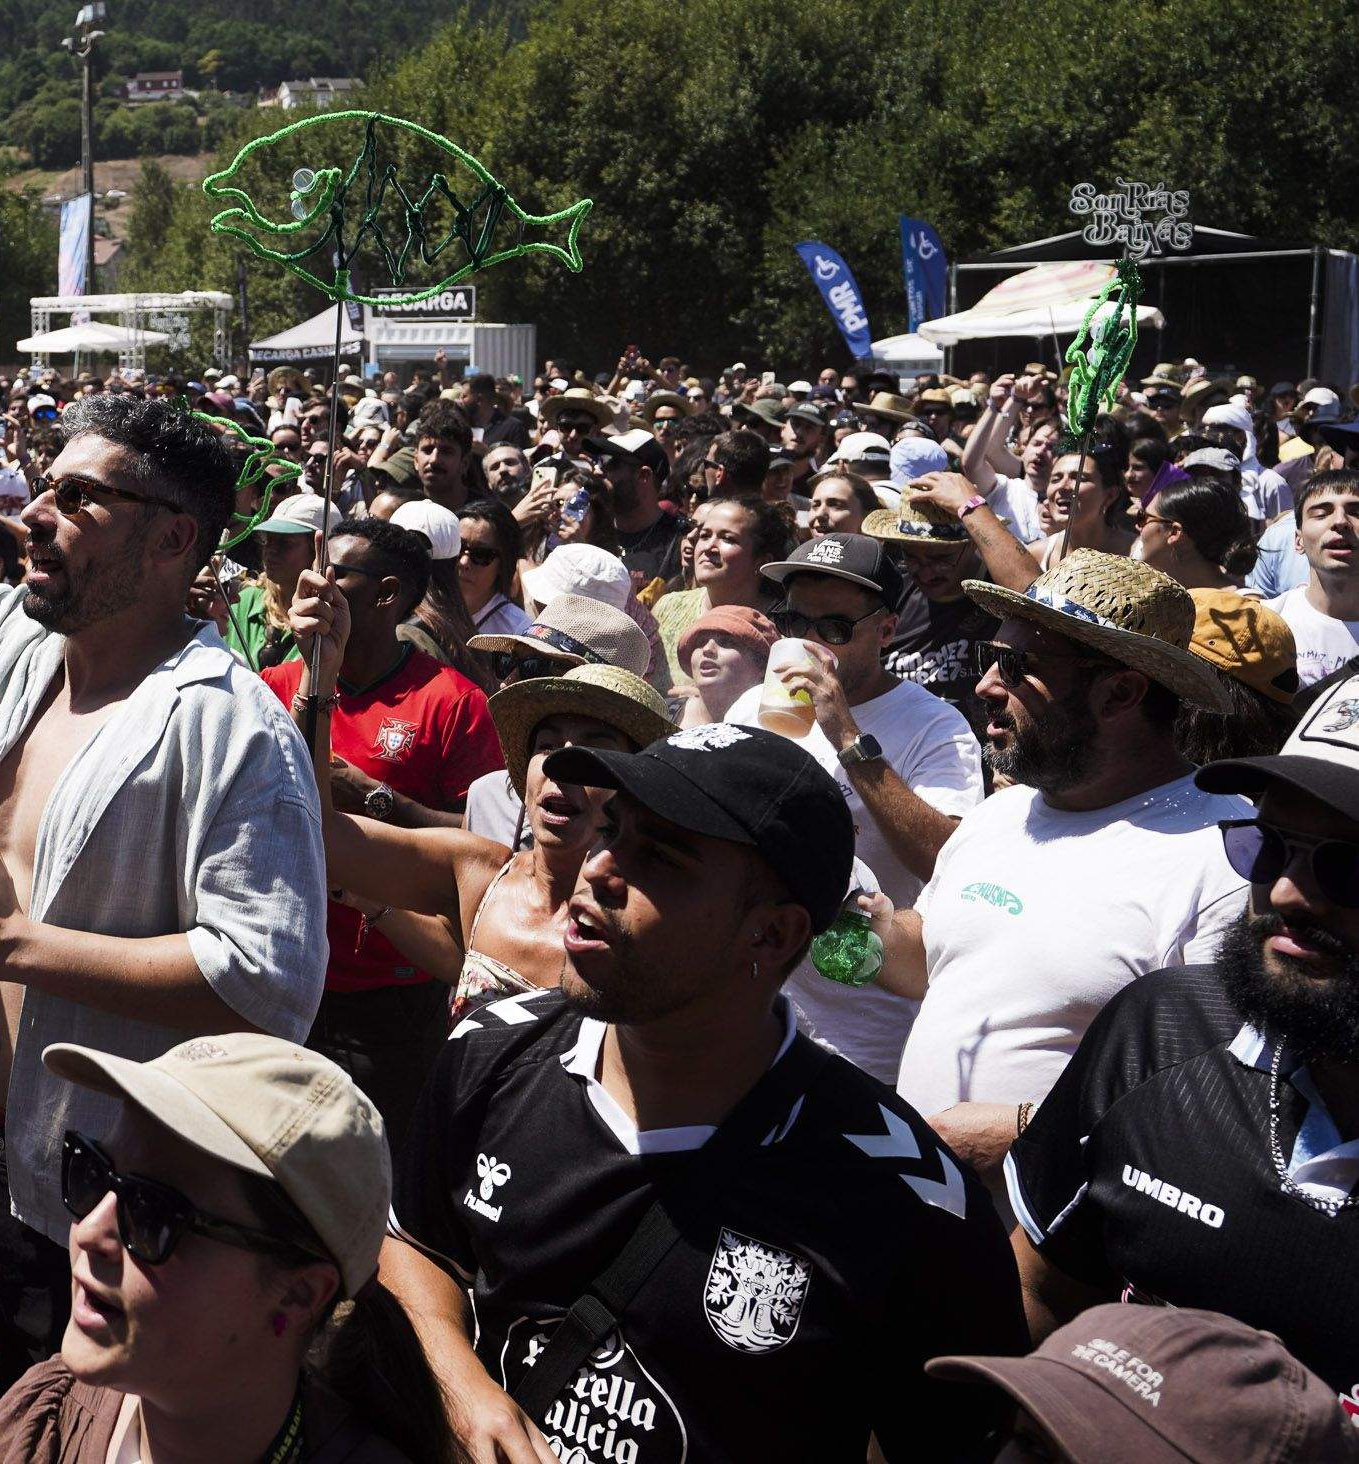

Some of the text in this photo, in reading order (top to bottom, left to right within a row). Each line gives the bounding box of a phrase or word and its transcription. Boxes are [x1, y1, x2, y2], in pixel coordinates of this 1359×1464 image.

[829, 281, 868, 333] PMR
[463, 1189, 502, 1223] hummel
[1122, 1164, 1225, 1228] UMBRO
[1093, 1354, 1161, 1407] CAMERA
[1125, 1357, 1164, 1388] FOR
[544, 1398, 639, 1464] alicia
